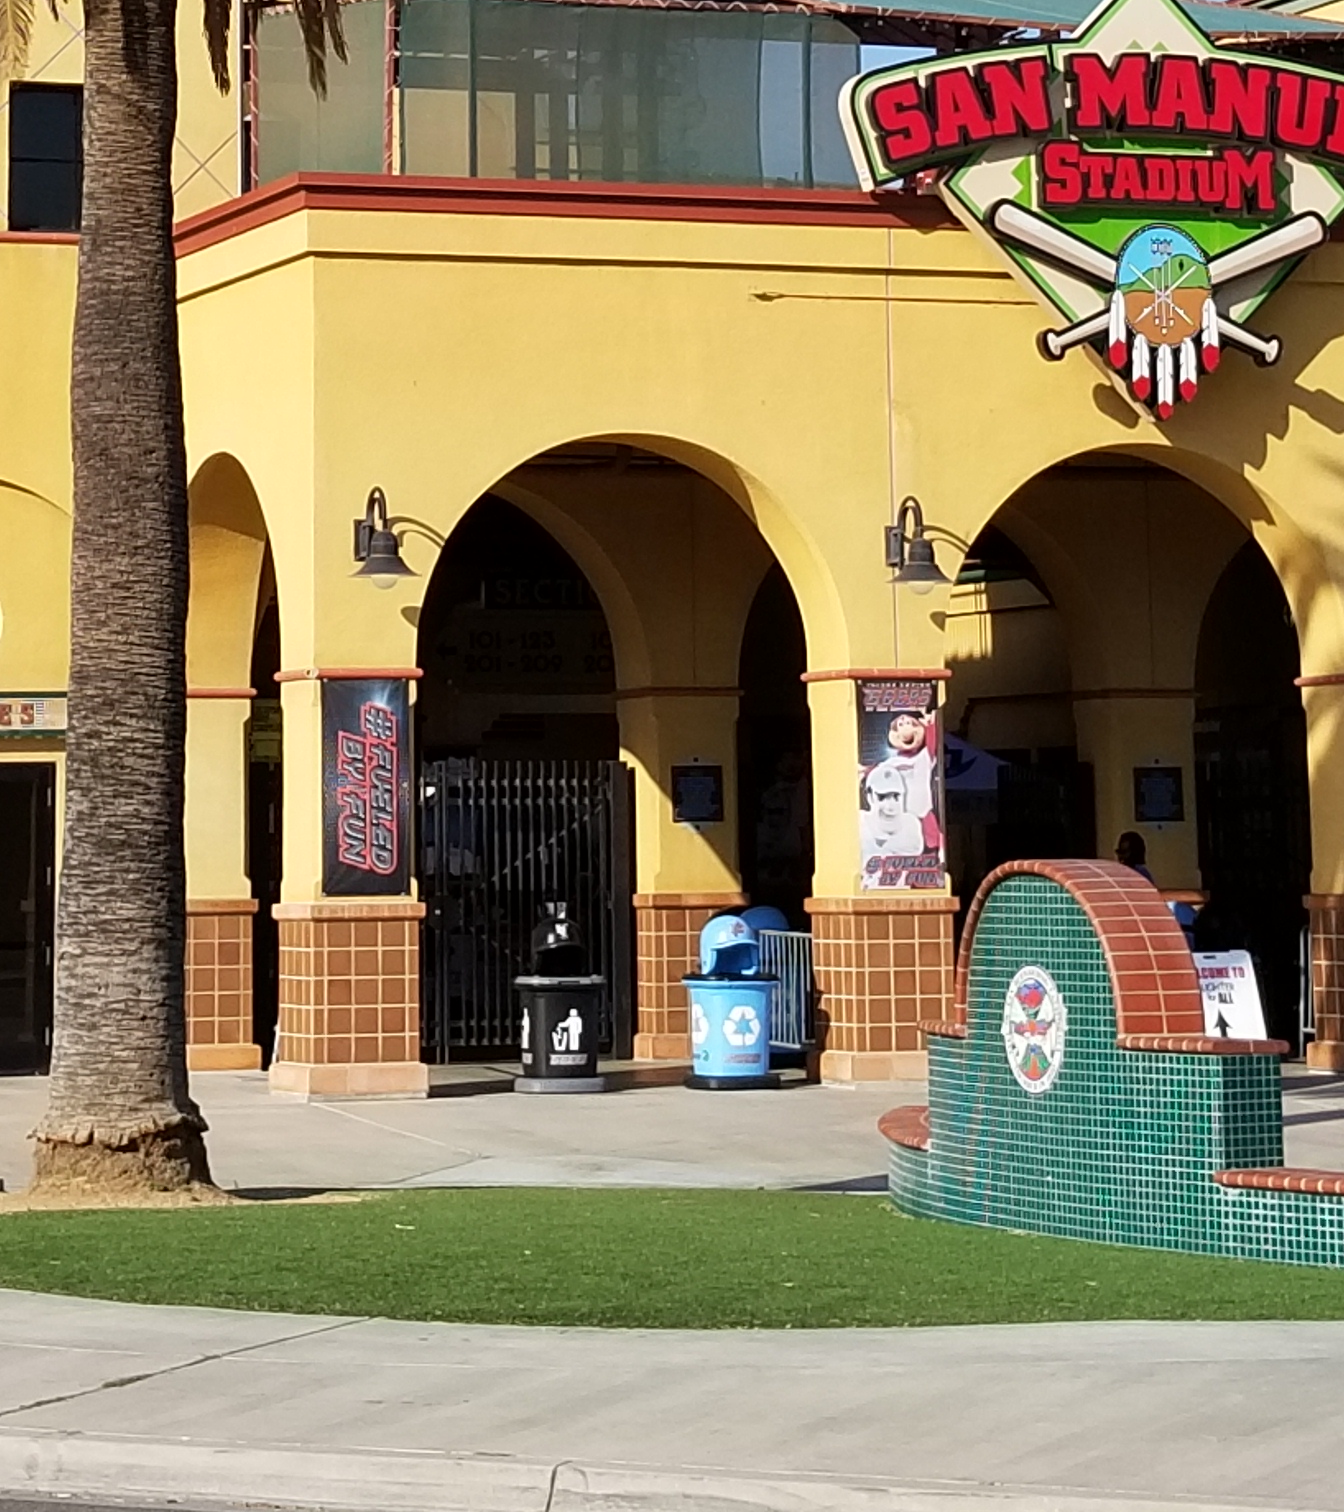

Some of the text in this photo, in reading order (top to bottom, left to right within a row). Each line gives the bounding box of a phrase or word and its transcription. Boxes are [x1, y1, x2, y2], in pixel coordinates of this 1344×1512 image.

[871, 56, 1053, 164] SAN
[1040, 142, 1276, 211] STADIUM
[342, 736, 366, 864] BY FUN
[364, 705, 394, 871] #FUELED
[1231, 965, 1245, 979] TO
